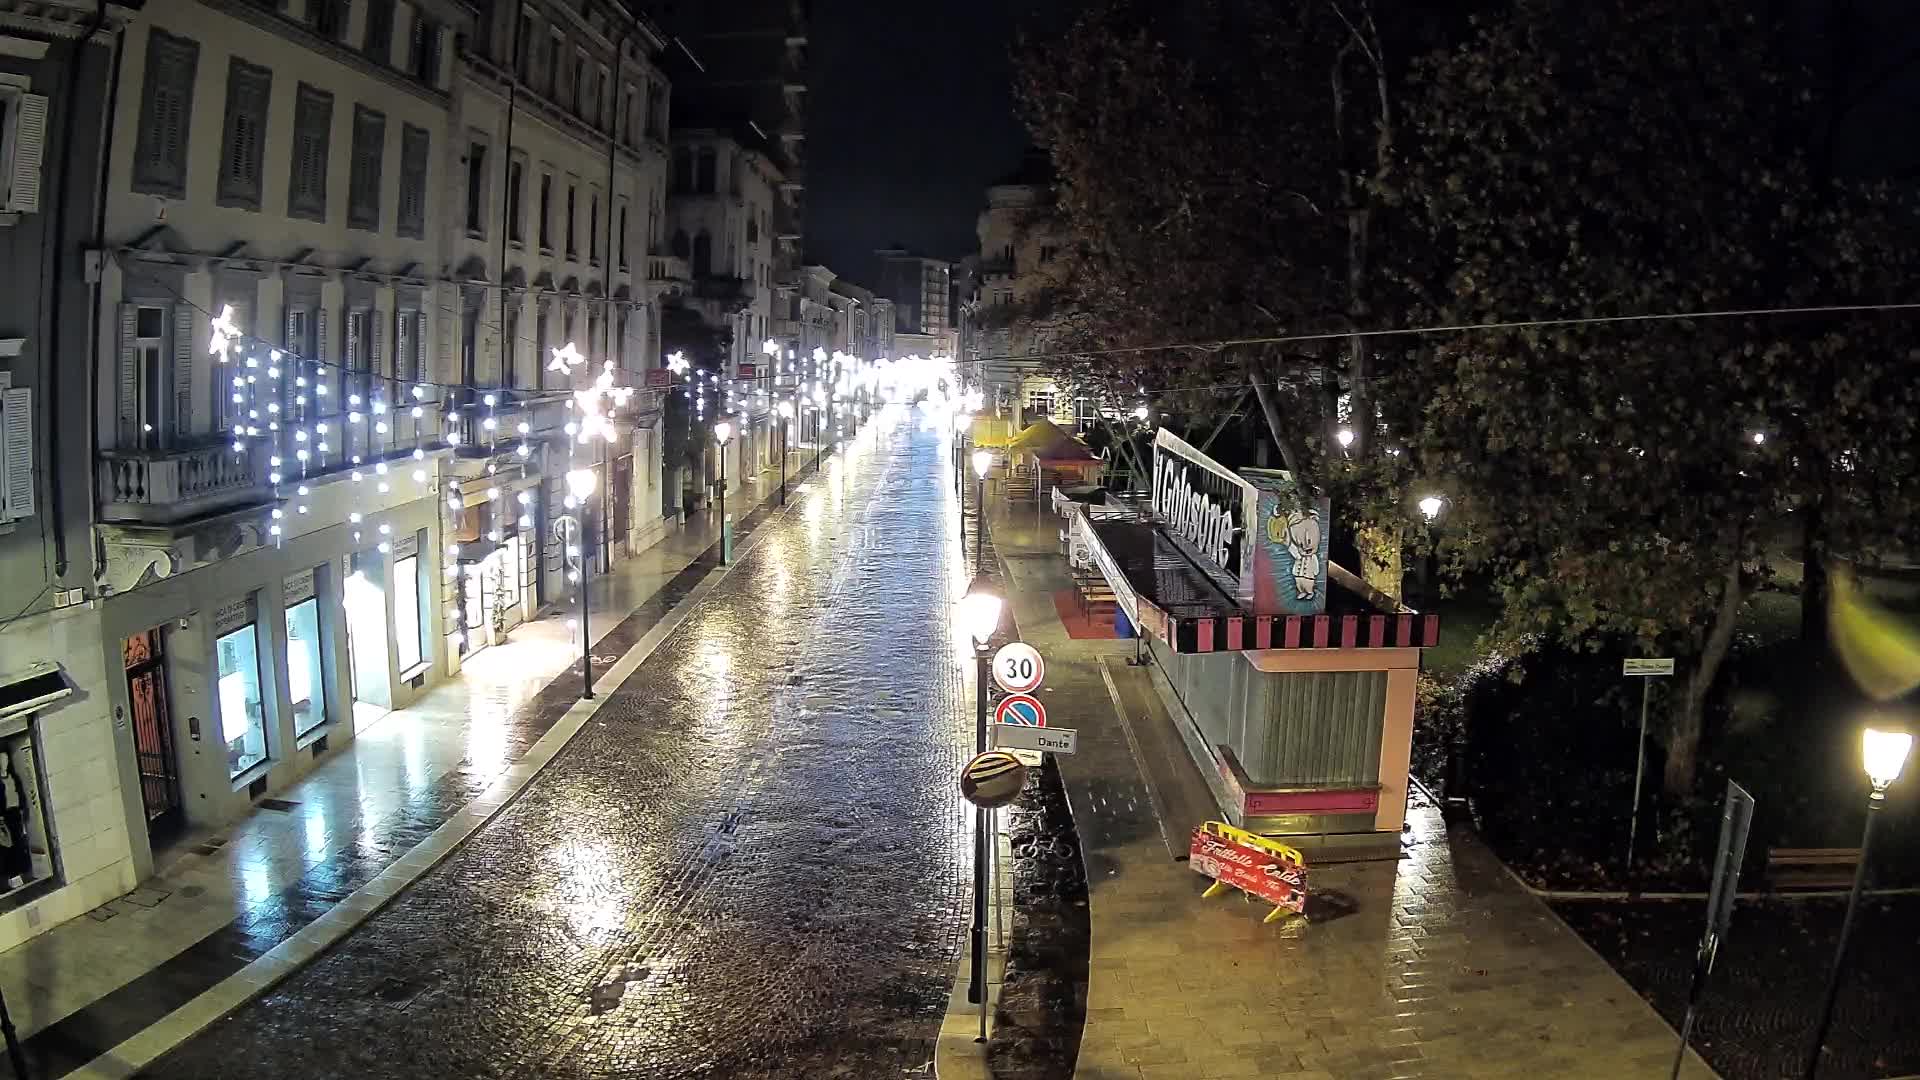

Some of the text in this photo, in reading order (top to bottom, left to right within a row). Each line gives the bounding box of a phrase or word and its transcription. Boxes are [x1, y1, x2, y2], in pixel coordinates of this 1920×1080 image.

[1162, 458, 1233, 570] Golosone
[1006, 658, 1032, 679] 30
[1038, 736, 1070, 749] Dante
